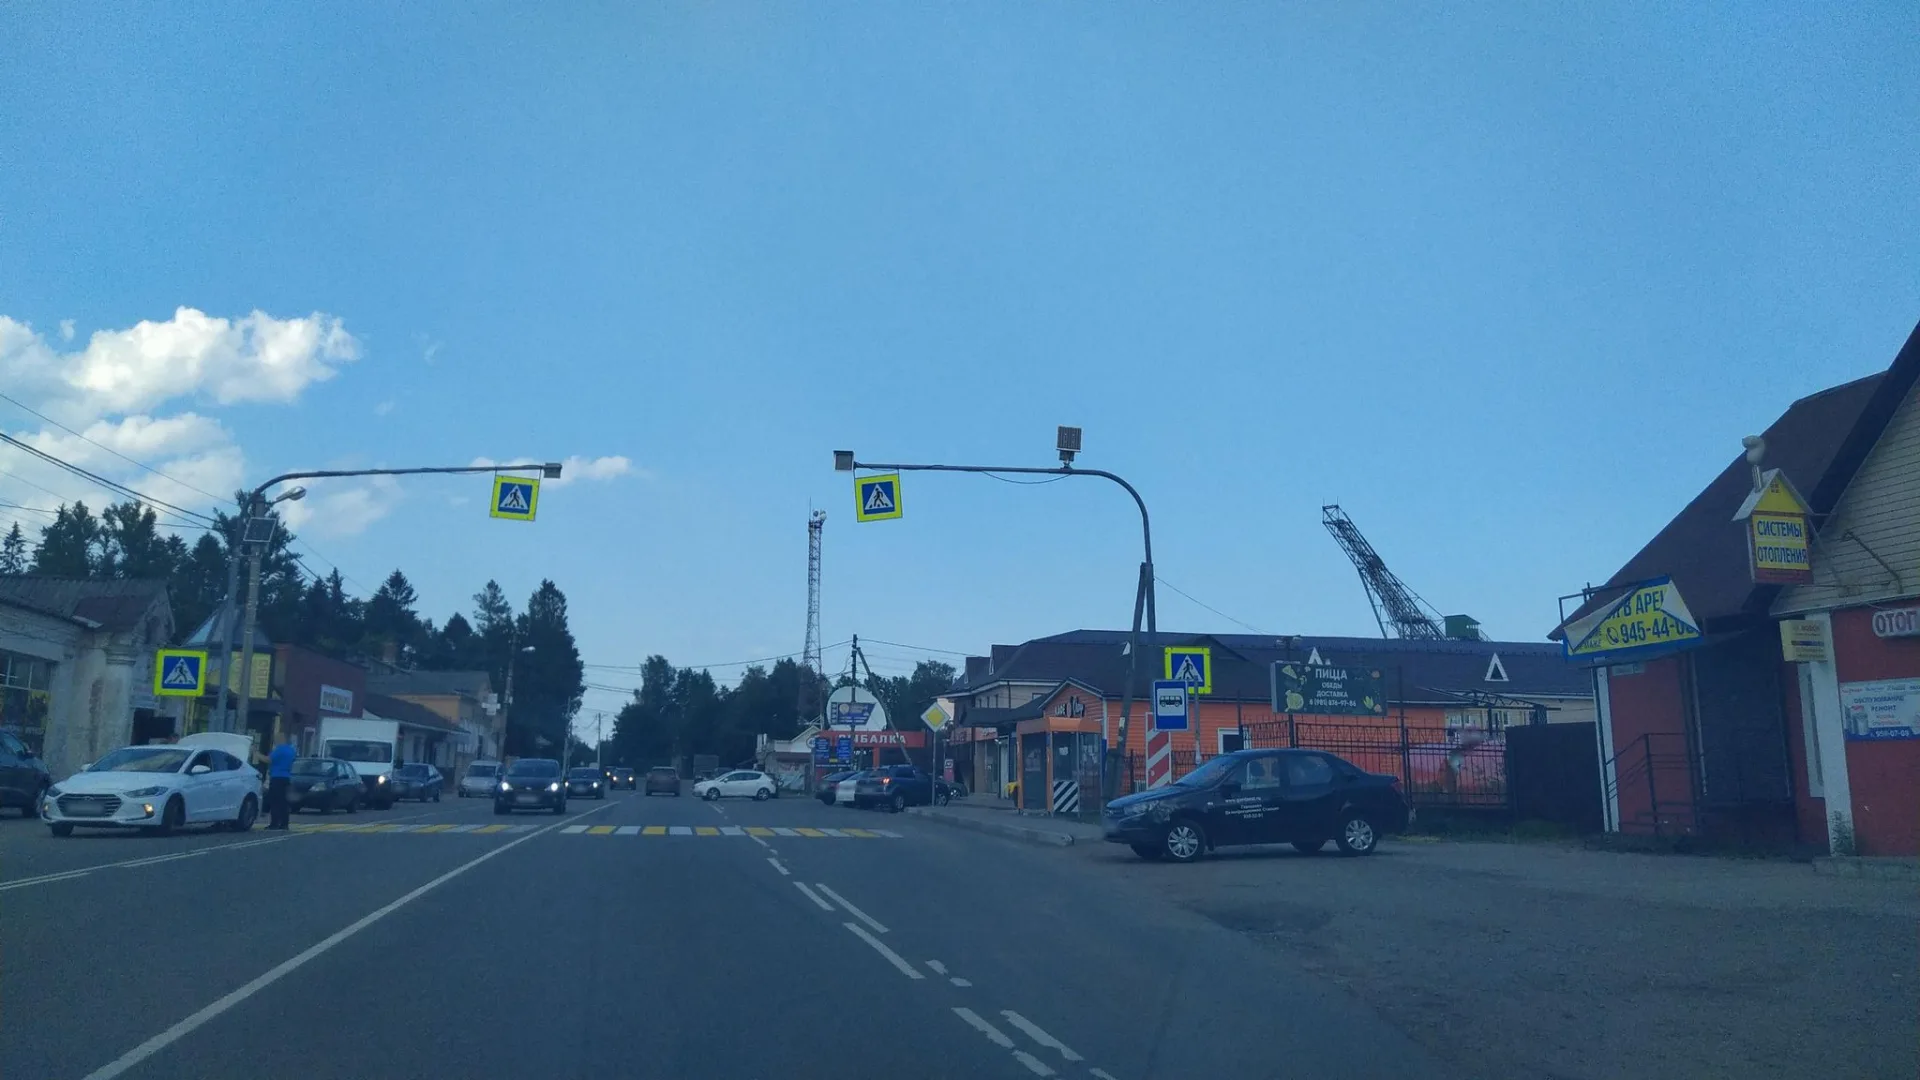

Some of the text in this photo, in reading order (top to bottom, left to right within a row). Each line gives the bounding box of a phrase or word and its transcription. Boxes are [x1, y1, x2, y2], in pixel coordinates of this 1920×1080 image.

[1757, 519, 1802, 538] СИСТЕМЫ
[1757, 545, 1808, 564] ОТОПЛЕНИЯ
[1315, 668, 1348, 680] ПИЩА
[1316, 690, 1349, 698] ДОСТАВКА
[1871, 704, 1897, 712] РЕМОНТ
